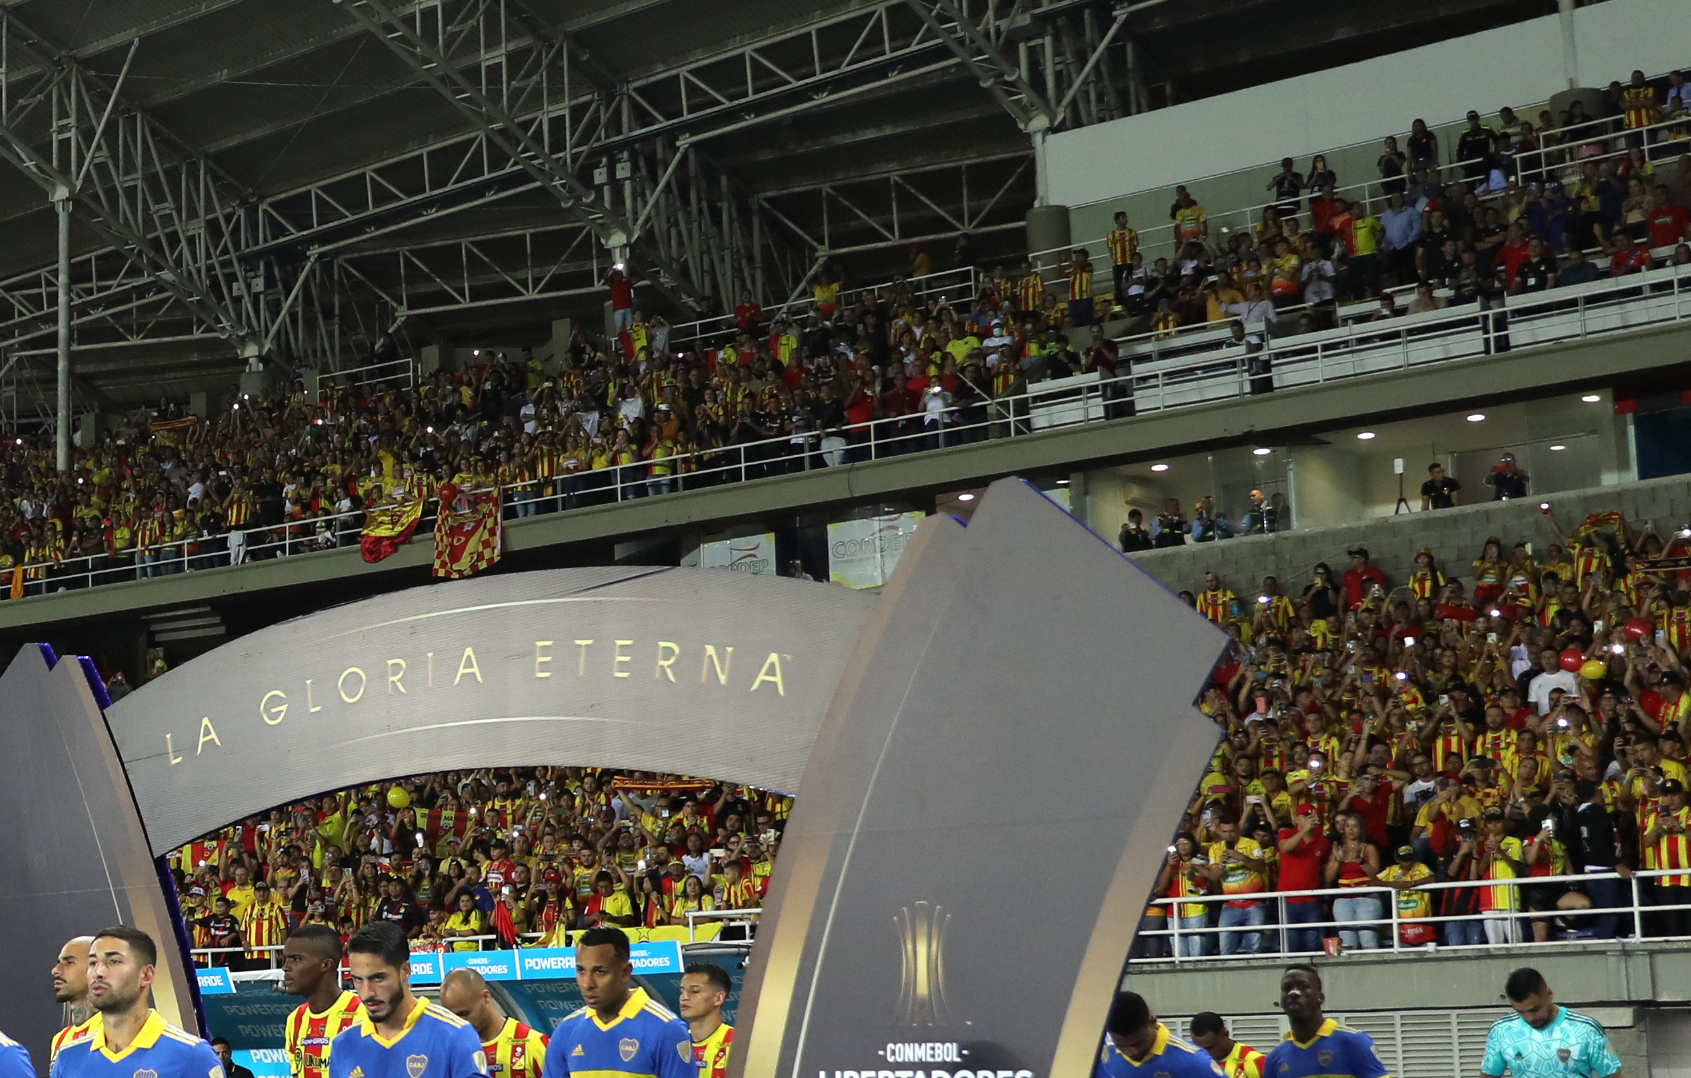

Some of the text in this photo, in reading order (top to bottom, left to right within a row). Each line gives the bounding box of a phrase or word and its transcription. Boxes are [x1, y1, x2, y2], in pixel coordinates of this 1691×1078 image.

[166, 638, 786, 766] LA GLORIA ETERNA
